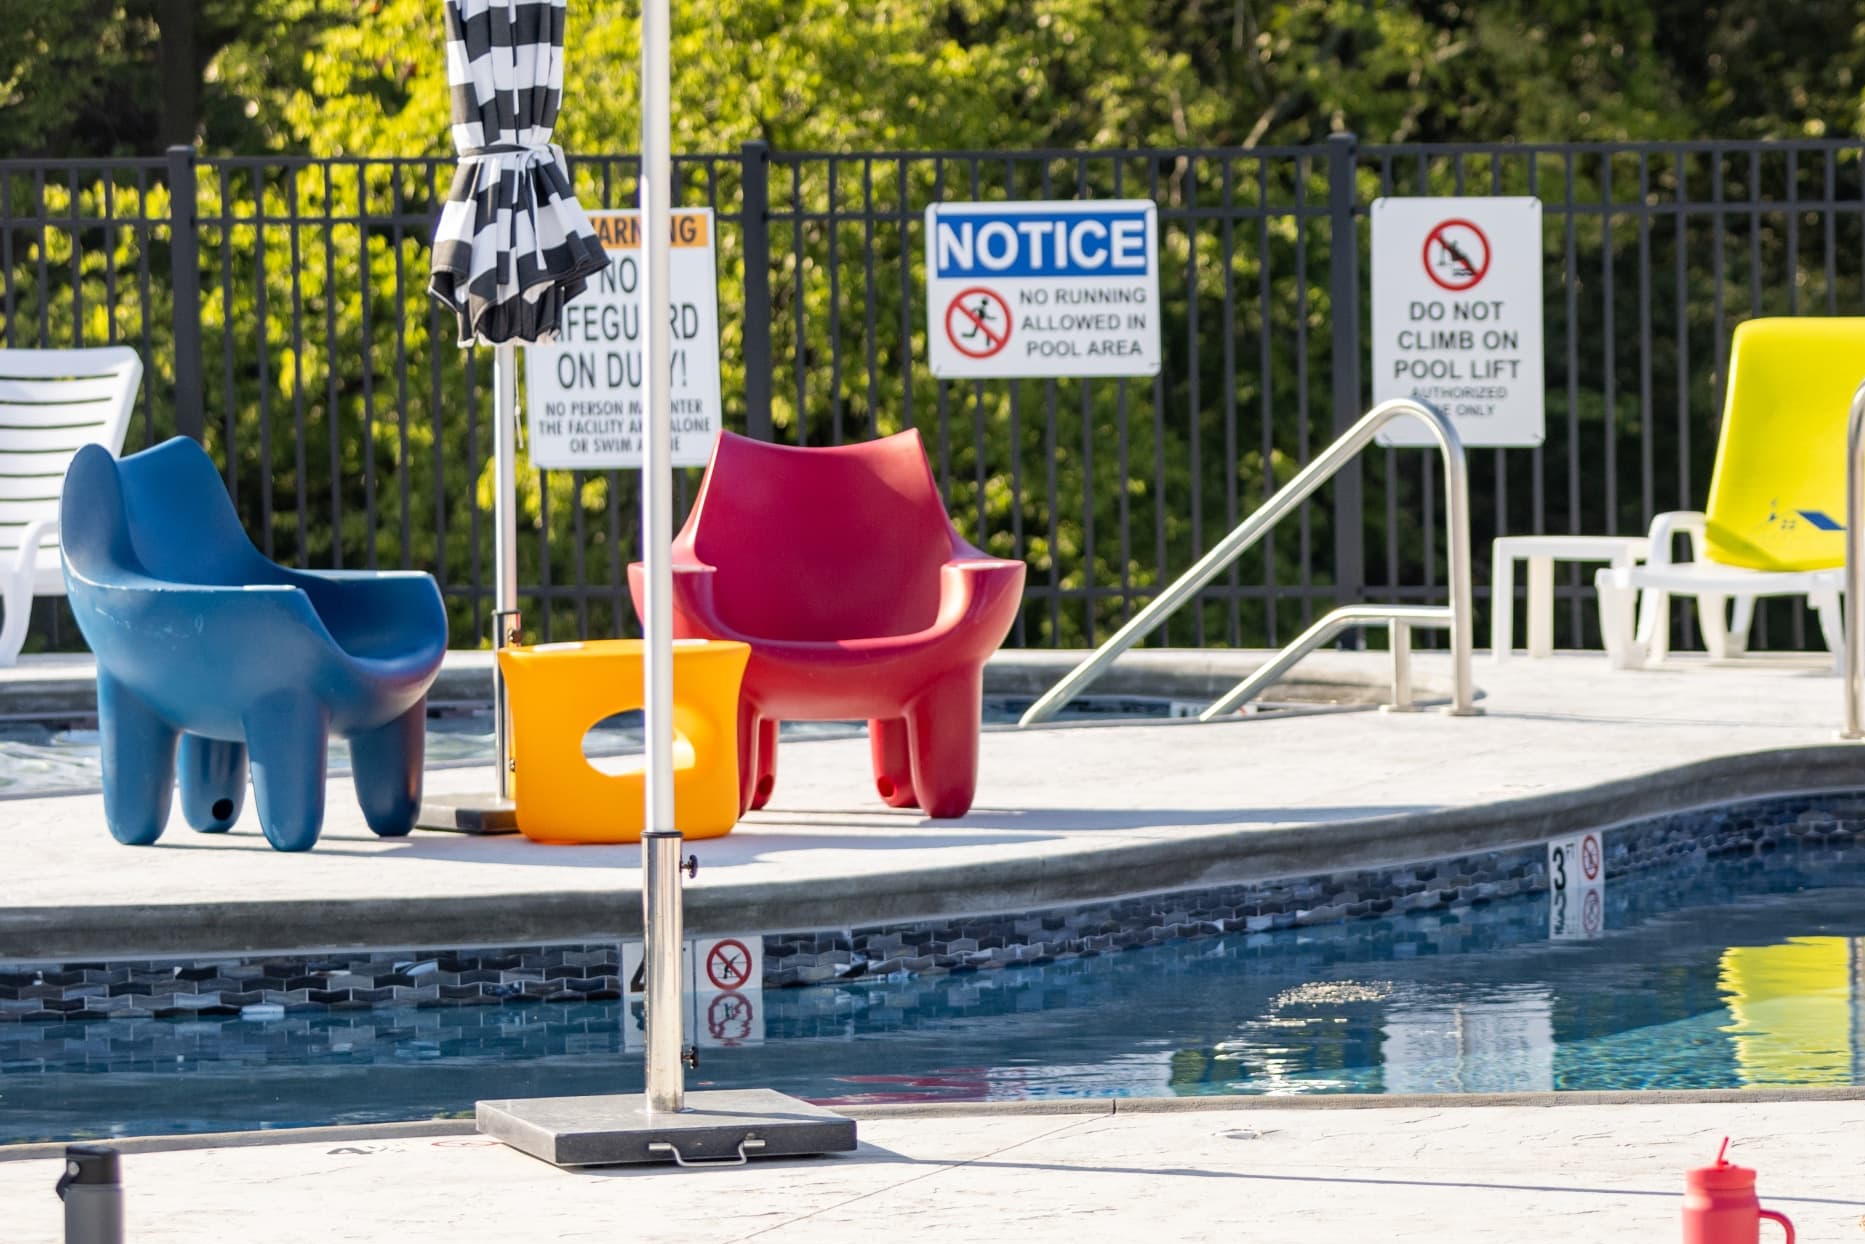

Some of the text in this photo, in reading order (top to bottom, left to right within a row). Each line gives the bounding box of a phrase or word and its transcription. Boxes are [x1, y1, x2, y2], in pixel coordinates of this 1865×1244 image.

[590, 215, 697, 244] ARNG
[937, 220, 1146, 271] NOTICE
[601, 257, 638, 294] NO
[1020, 287, 1147, 305] NO RUNNING
[1409, 301, 1504, 321] DO NOT
[1021, 313, 1146, 331] ALLOWED IN
[1026, 339, 1143, 357] POOL AREA
[1397, 330, 1519, 350] CLIMB ON
[557, 350, 687, 390] ON DUY!
[1393, 359, 1521, 380] POOL LIFT
[545, 402, 566, 417] NO
[571, 401, 624, 417] PERSON
[669, 399, 703, 414] NTER
[538, 421, 562, 435] THE
[568, 419, 623, 435] FACILITY
[570, 440, 586, 454] OR
[593, 438, 633, 453] SWIM
[1552, 846, 1567, 891] 3
